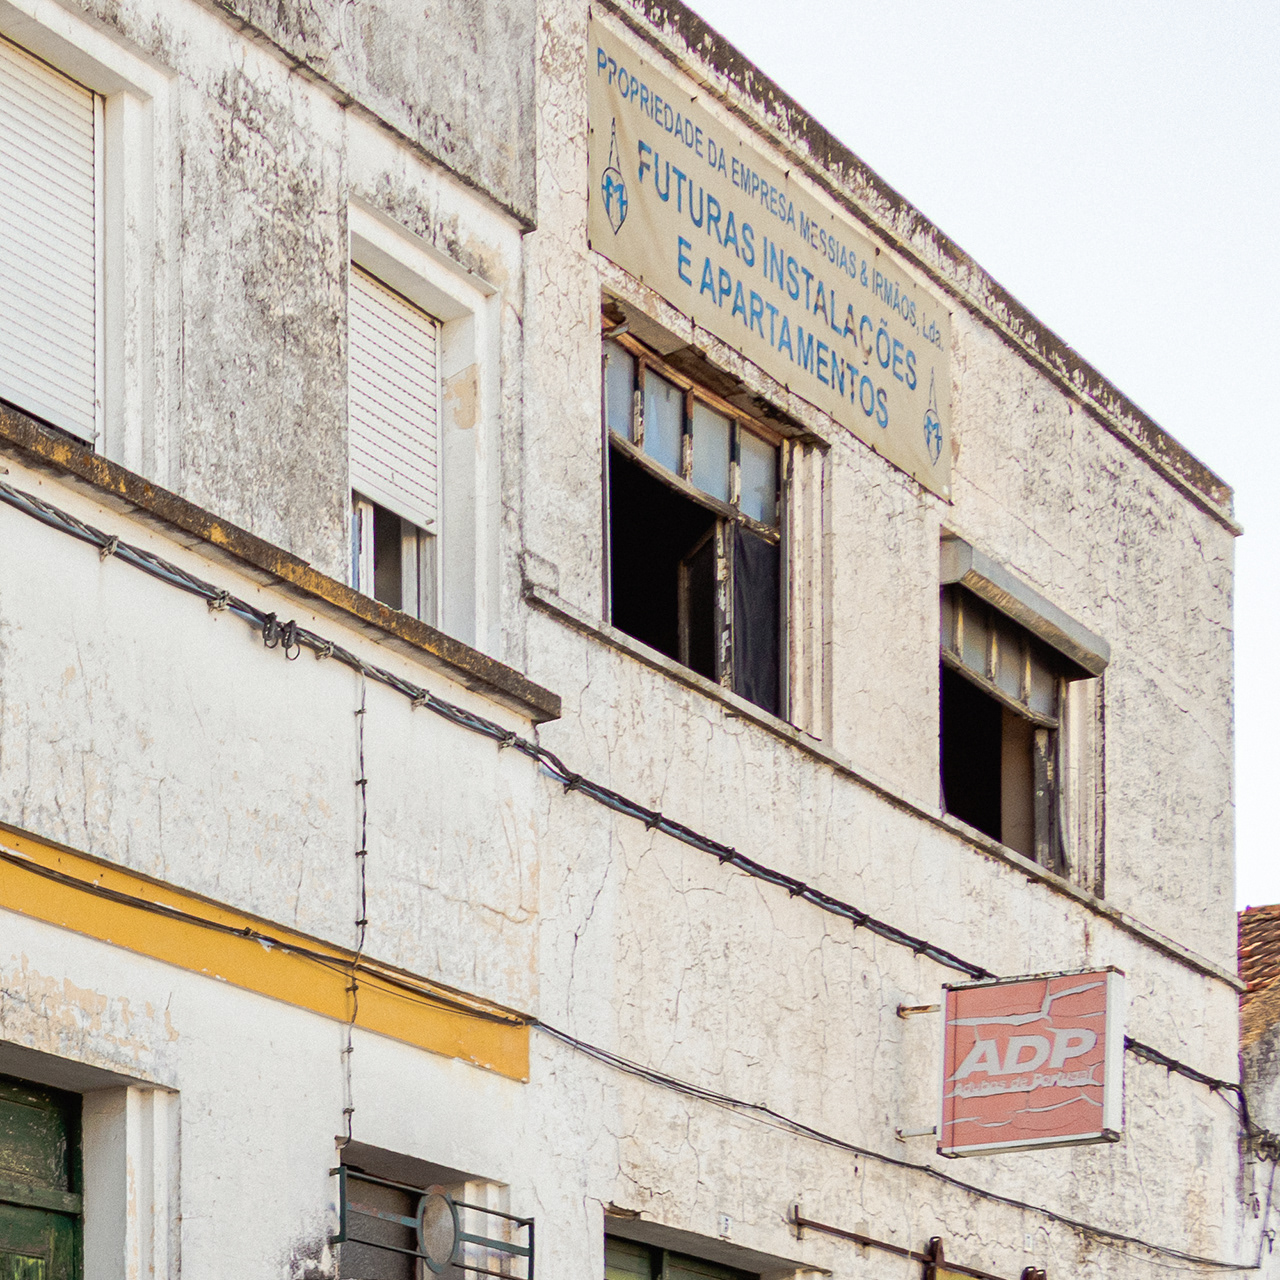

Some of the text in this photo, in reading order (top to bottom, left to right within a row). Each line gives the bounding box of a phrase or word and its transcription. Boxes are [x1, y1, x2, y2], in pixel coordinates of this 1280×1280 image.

[597, 47, 703, 158] PROPRIEDADE
[708, 138, 727, 178] DA
[732, 156, 796, 231] EMPRESA
[800, 211, 856, 279] MESSIAS
[860, 260, 868, 288] &
[638, 140, 918, 391] FUTURAS INSTALAÇÕES
[678, 235, 889, 429] E APARTAMENTOS
[952, 1028, 1097, 1080] ADP
